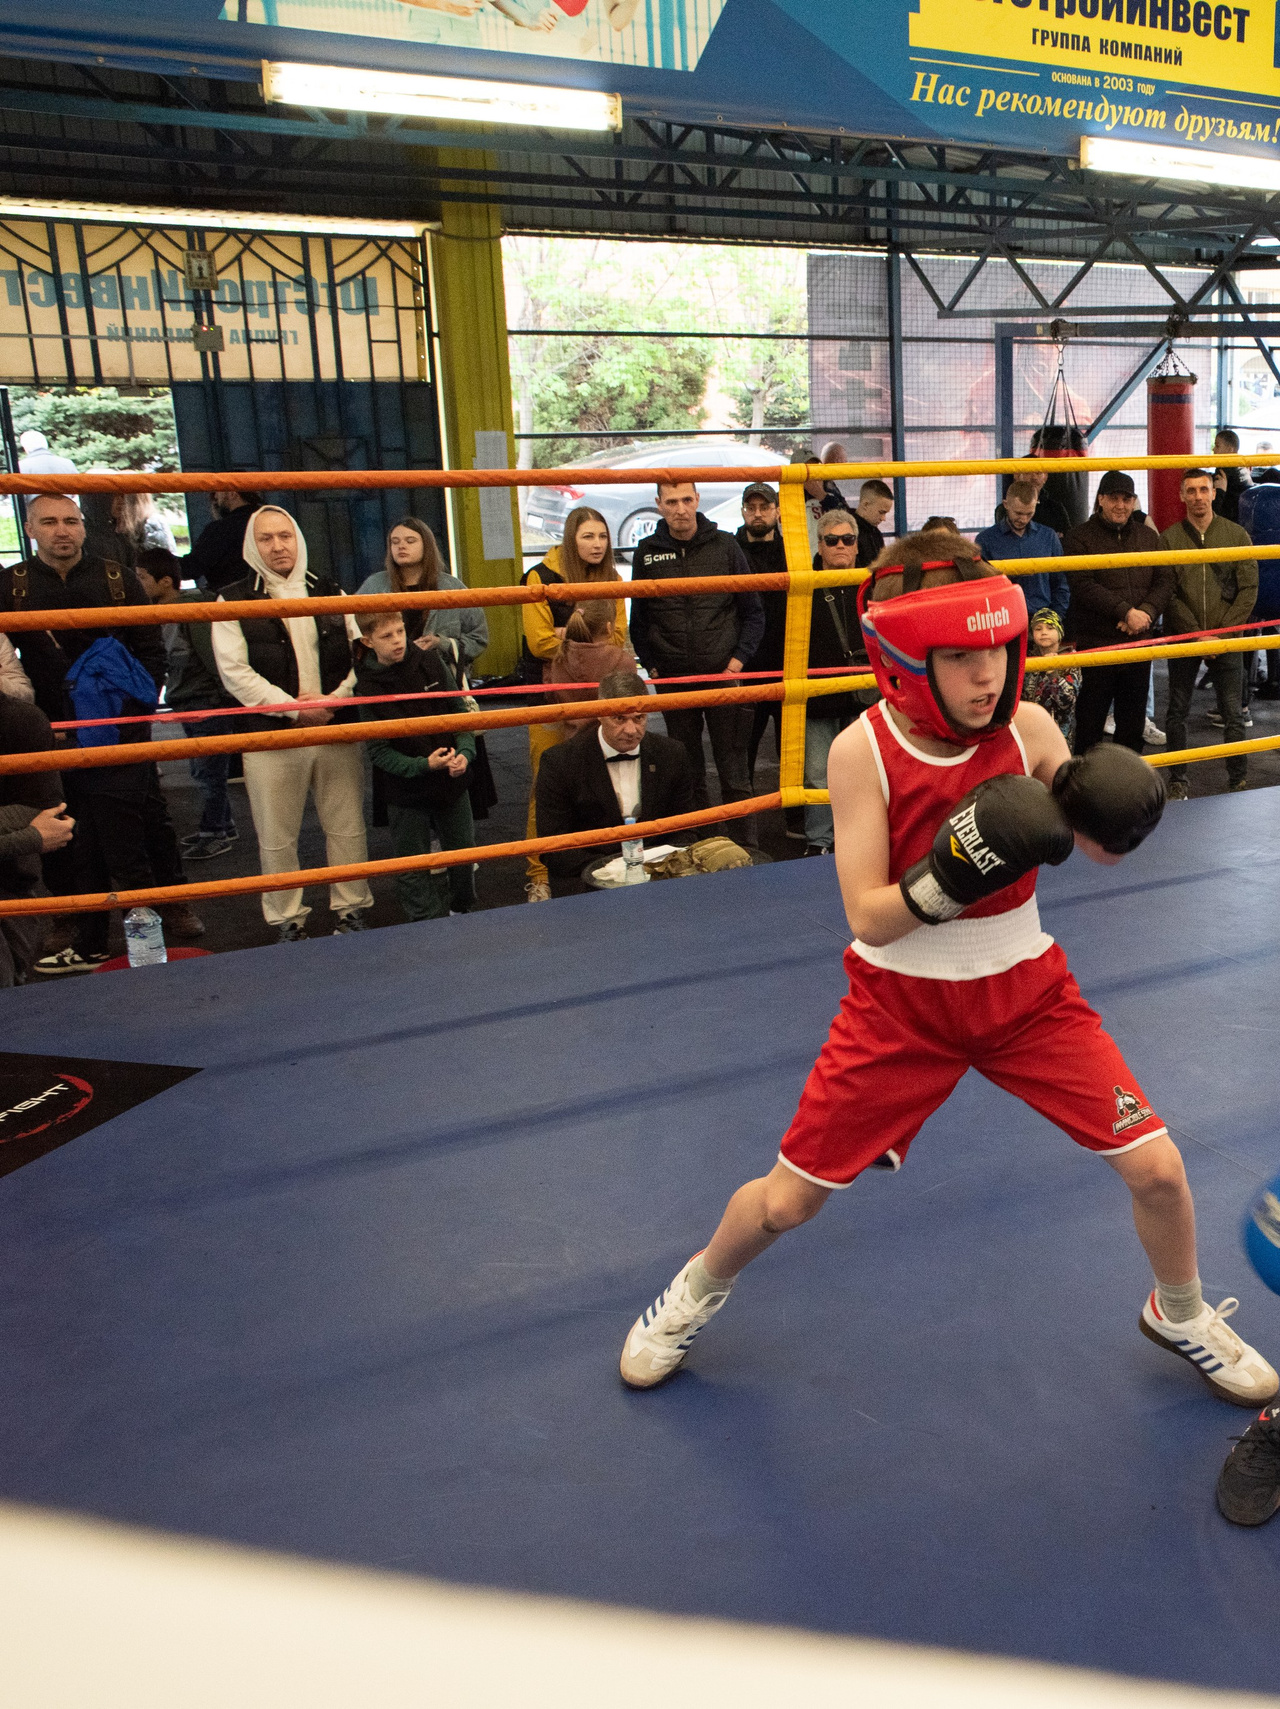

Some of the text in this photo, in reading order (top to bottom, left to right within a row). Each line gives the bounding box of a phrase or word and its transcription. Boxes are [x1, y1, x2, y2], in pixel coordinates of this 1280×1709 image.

[1032, 28, 1183, 66] ГРУППА КОМПАНИЙ
[1051, 71, 1092, 87] ОСНОВАНА
[1103, 76, 1134, 93] 2003
[909, 71, 970, 106] Нас
[975, 89, 1167, 131] рекомендуют
[653, 552, 676, 562] СИТИ
[967, 606, 1010, 633] clinch
[949, 802, 1006, 876] EVERLAST
